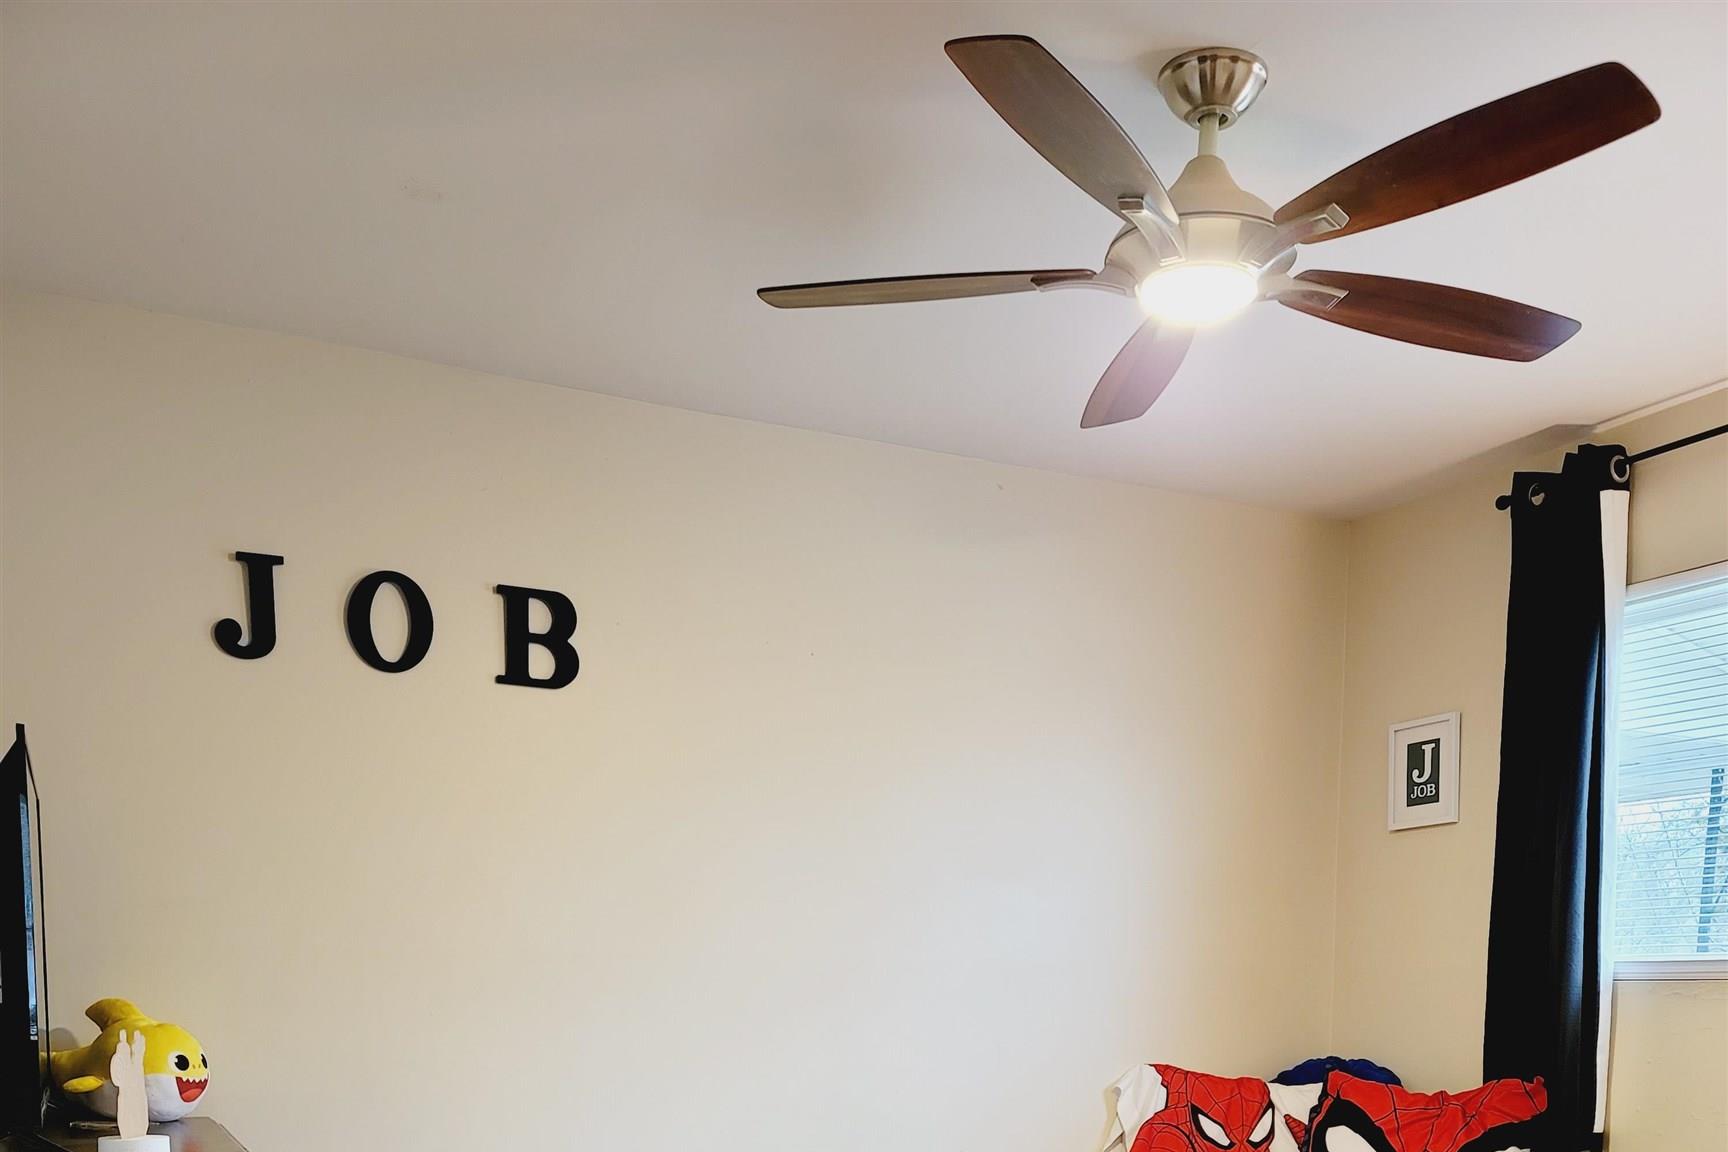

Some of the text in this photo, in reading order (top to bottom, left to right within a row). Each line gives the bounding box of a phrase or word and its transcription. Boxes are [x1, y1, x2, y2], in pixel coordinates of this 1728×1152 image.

[213, 550, 580, 690] JOB
[1411, 742, 1436, 783] J
[1410, 783, 1436, 799] JOB
